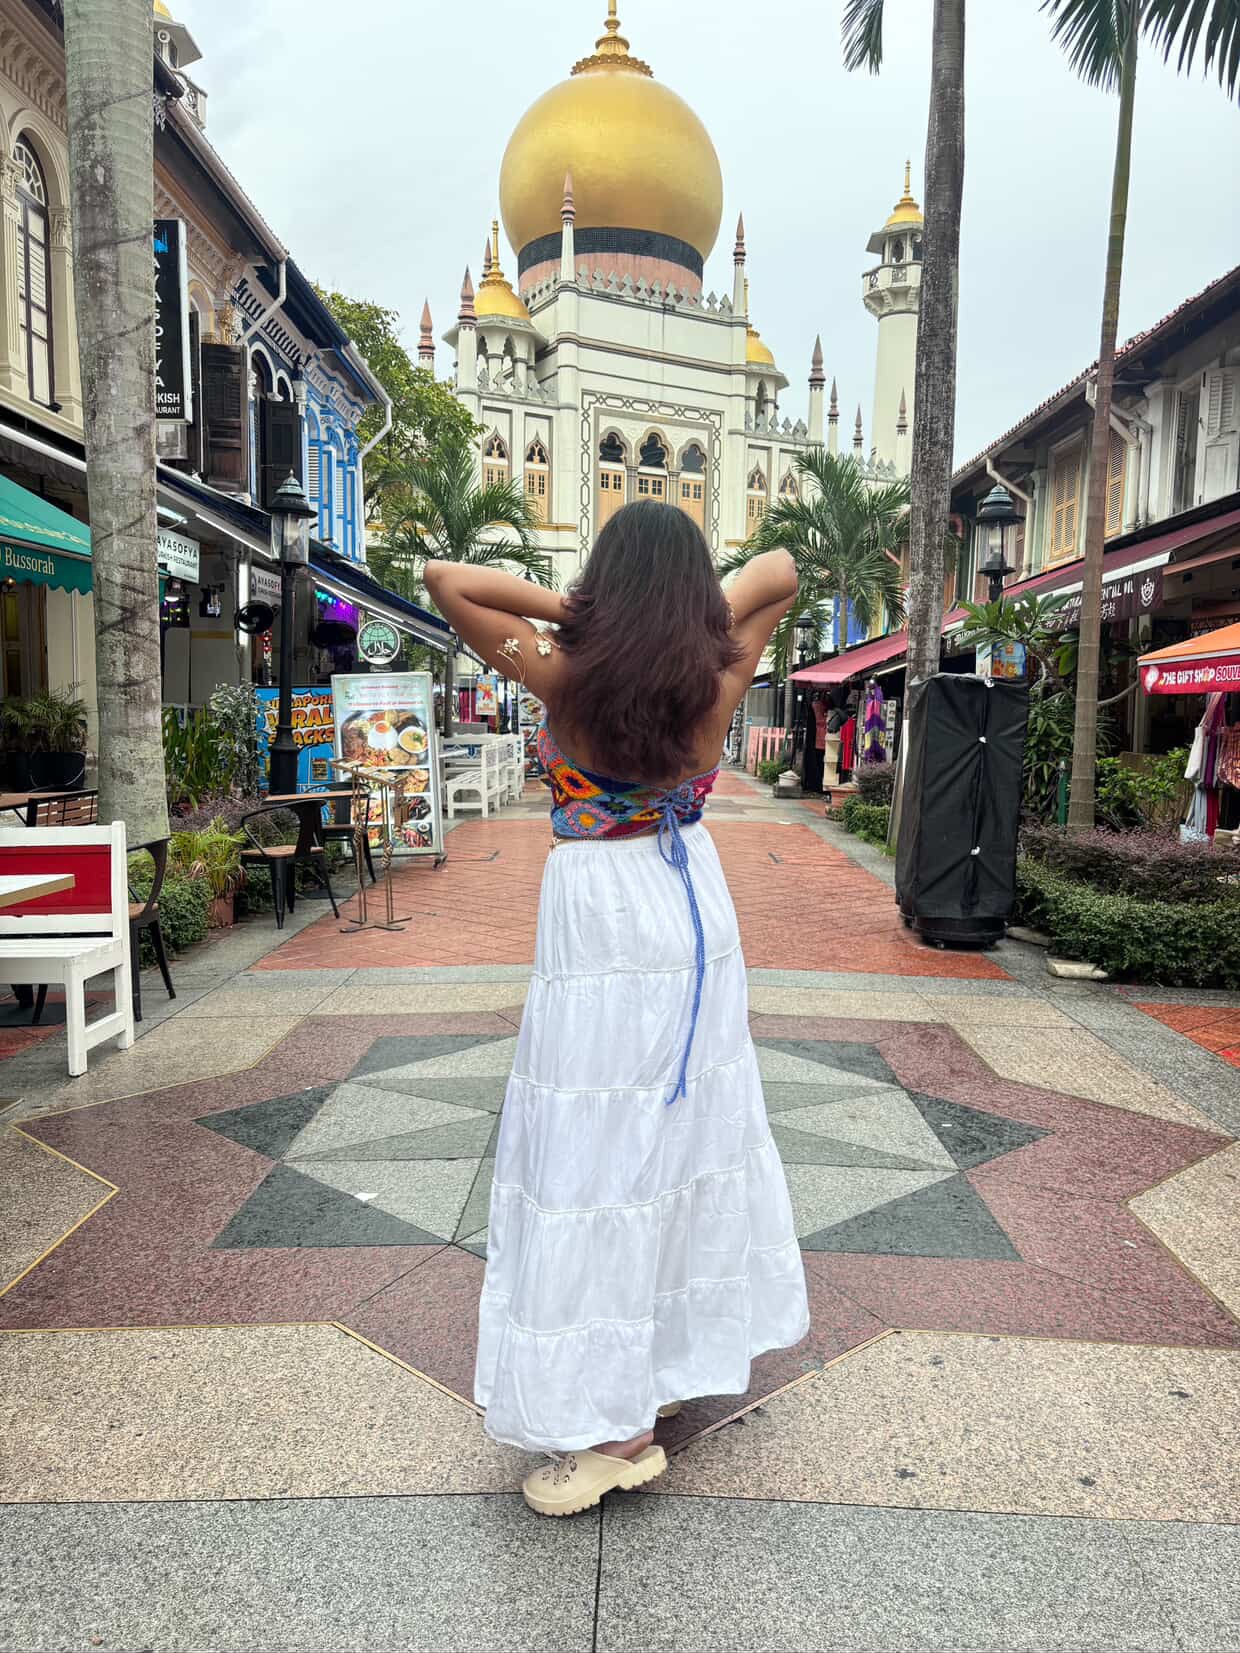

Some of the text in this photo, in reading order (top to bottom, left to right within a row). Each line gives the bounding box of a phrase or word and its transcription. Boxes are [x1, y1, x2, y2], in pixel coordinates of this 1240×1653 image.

[156, 391, 181, 404] KISH
[157, 535, 198, 560] AYASOFYA
[4, 546, 56, 576] Bussorah
[1162, 670, 1177, 686] THE
[1177, 669, 1194, 684] GIFT
